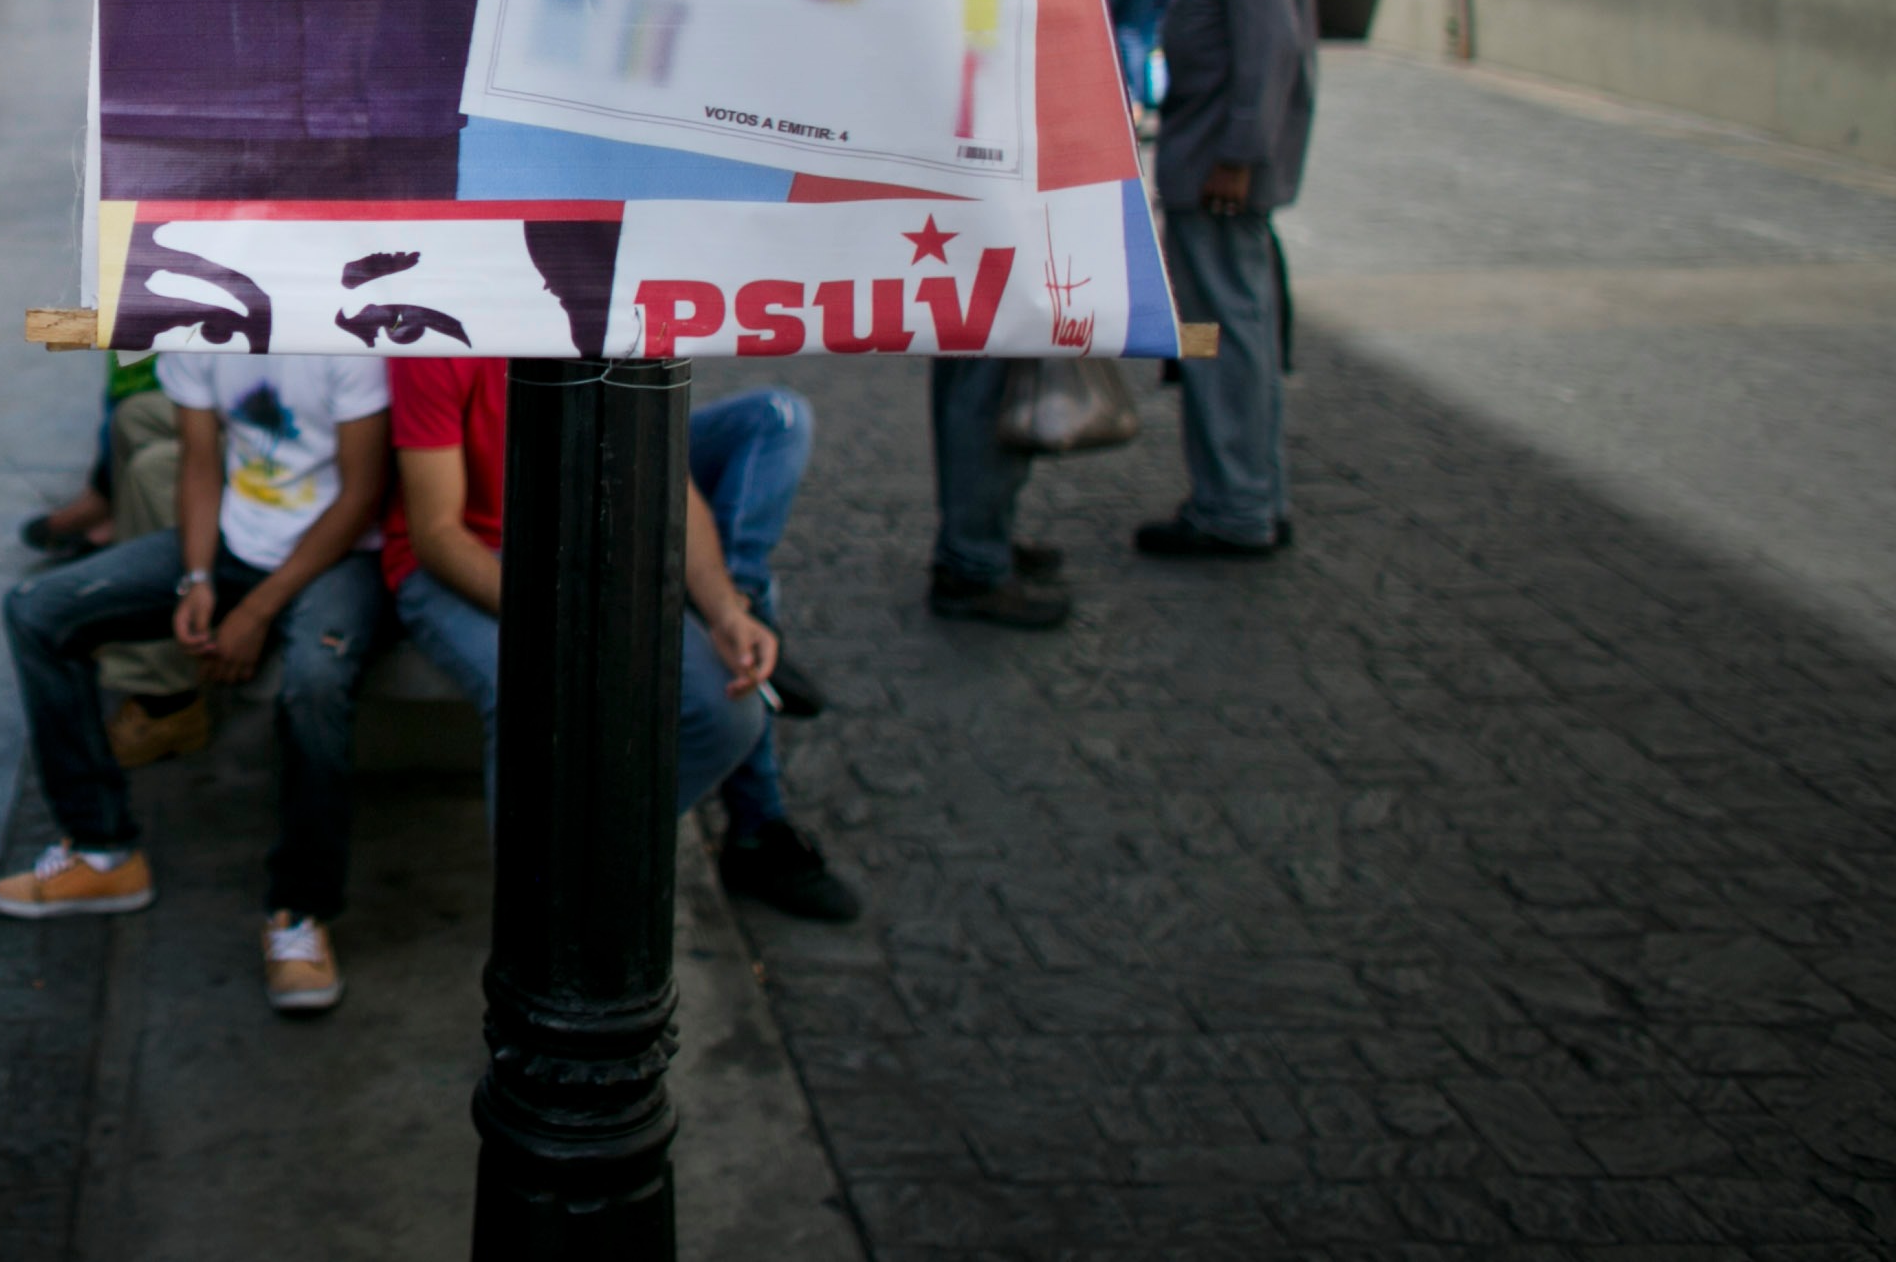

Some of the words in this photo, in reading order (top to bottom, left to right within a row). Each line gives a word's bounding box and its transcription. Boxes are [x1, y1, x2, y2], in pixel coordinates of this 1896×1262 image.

[704, 105, 758, 128] VOTOS
[762, 115, 774, 130] A
[777, 118, 836, 141] EMITIR:
[839, 130, 849, 143] 4
